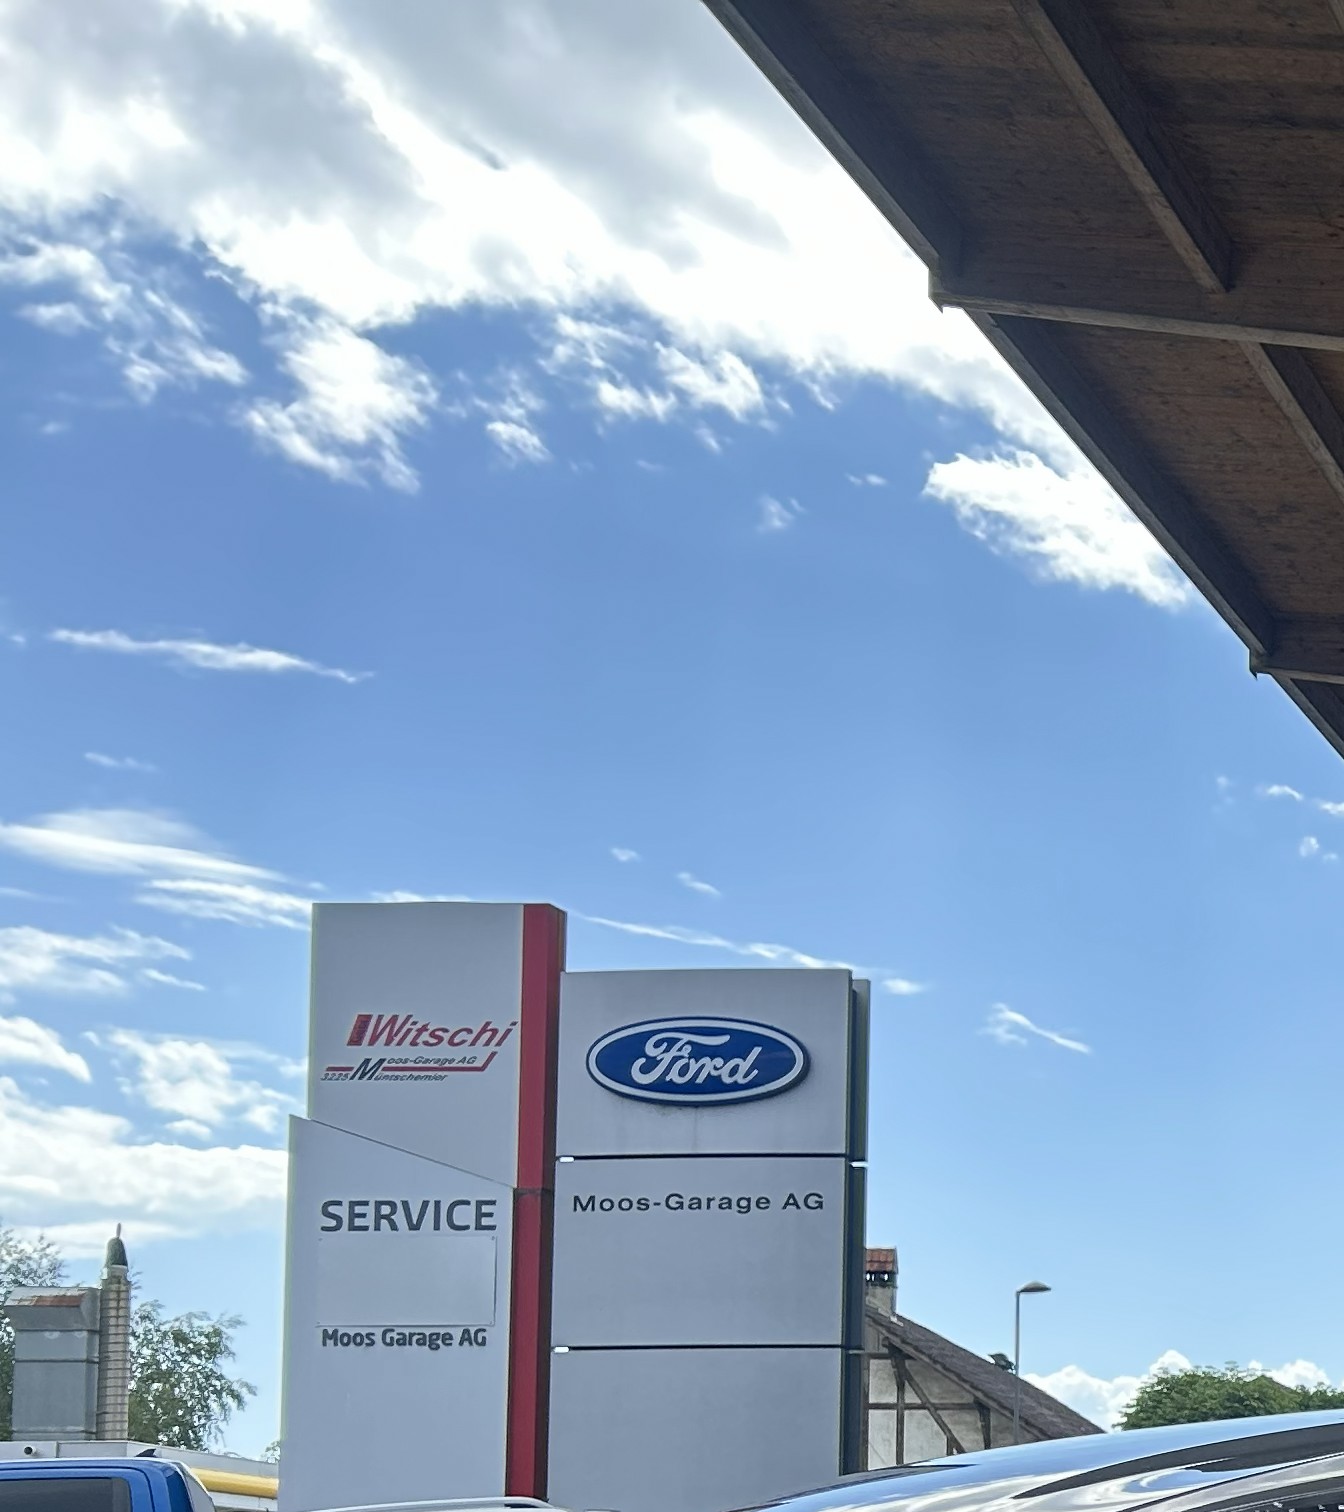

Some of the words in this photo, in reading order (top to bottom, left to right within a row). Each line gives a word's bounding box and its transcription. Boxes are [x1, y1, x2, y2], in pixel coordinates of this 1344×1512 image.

[367, 1014, 519, 1047] Witschi
[458, 1056, 478, 1065] AG
[630, 1031, 762, 1085] Ford
[320, 1199, 497, 1232] SERVICE
[573, 1193, 771, 1214] Moos-Garage
[782, 1192, 824, 1210] AG
[322, 1328, 376, 1347] Moos
[381, 1328, 453, 1351] Garage
[458, 1328, 487, 1347] AG
